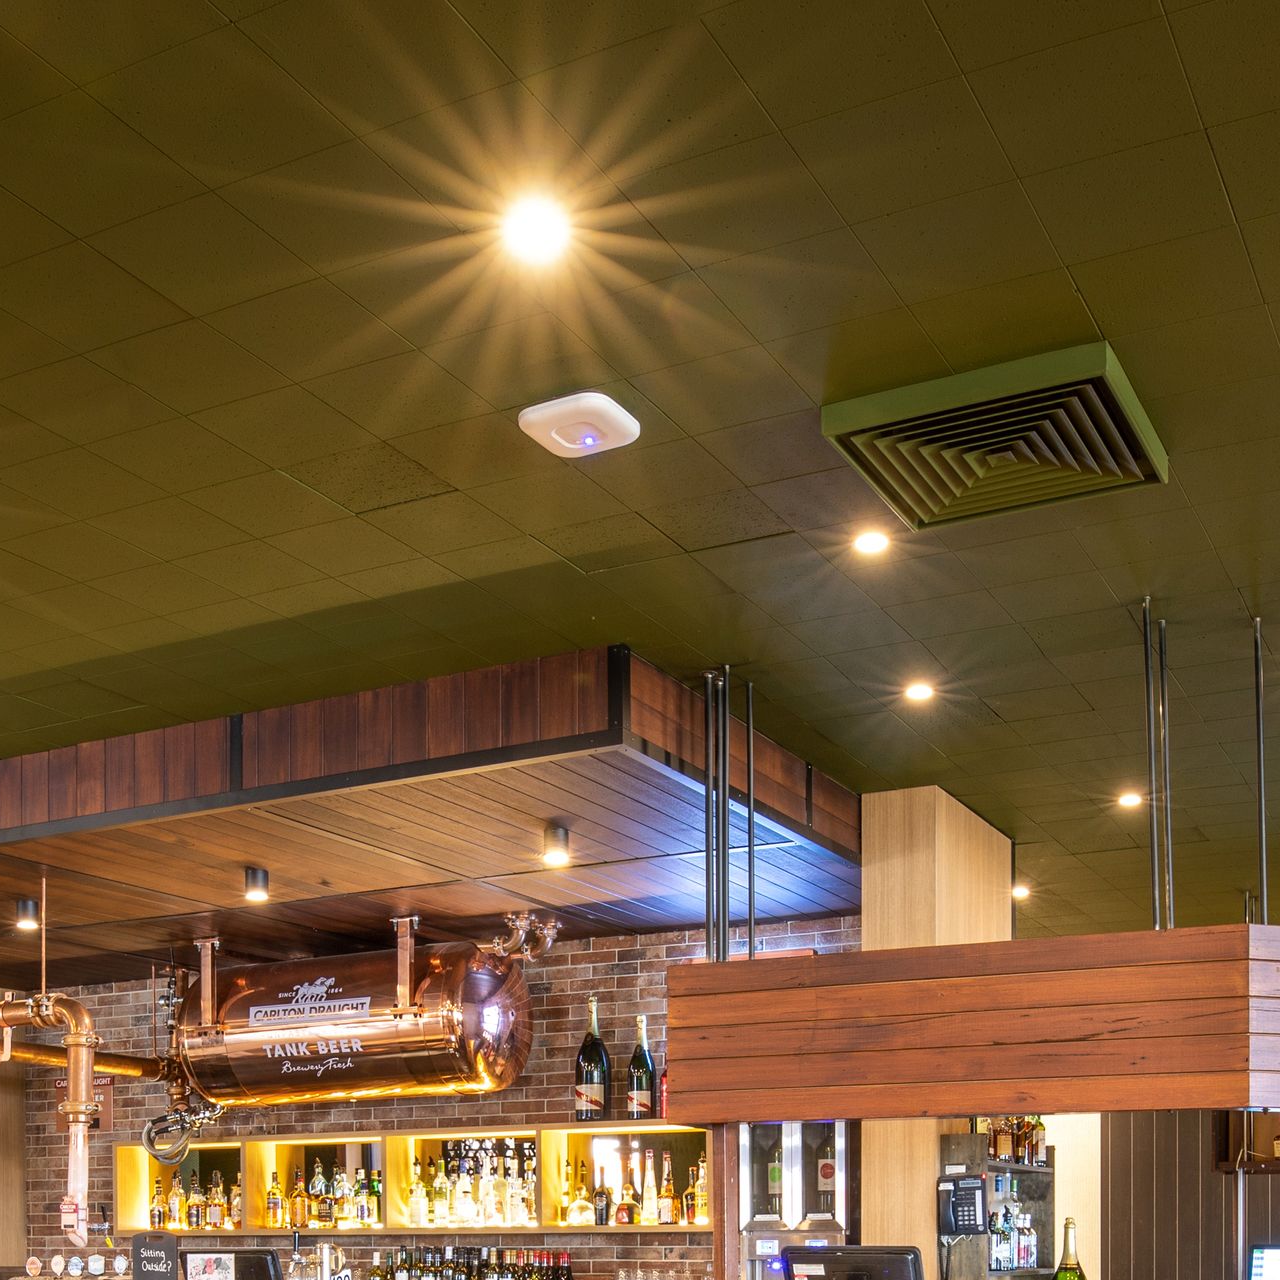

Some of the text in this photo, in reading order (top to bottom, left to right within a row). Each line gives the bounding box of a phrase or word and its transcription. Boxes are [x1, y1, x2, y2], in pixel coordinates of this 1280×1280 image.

[278, 991, 296, 999] SINCE
[254, 1002, 366, 1022] CARLTON DRAUGHT
[262, 1038, 364, 1058] TANK BEER
[281, 1057, 354, 1077] Brewery Fresh
[140, 1247, 166, 1262] Sitting
[141, 1260, 172, 1276] Outside?
